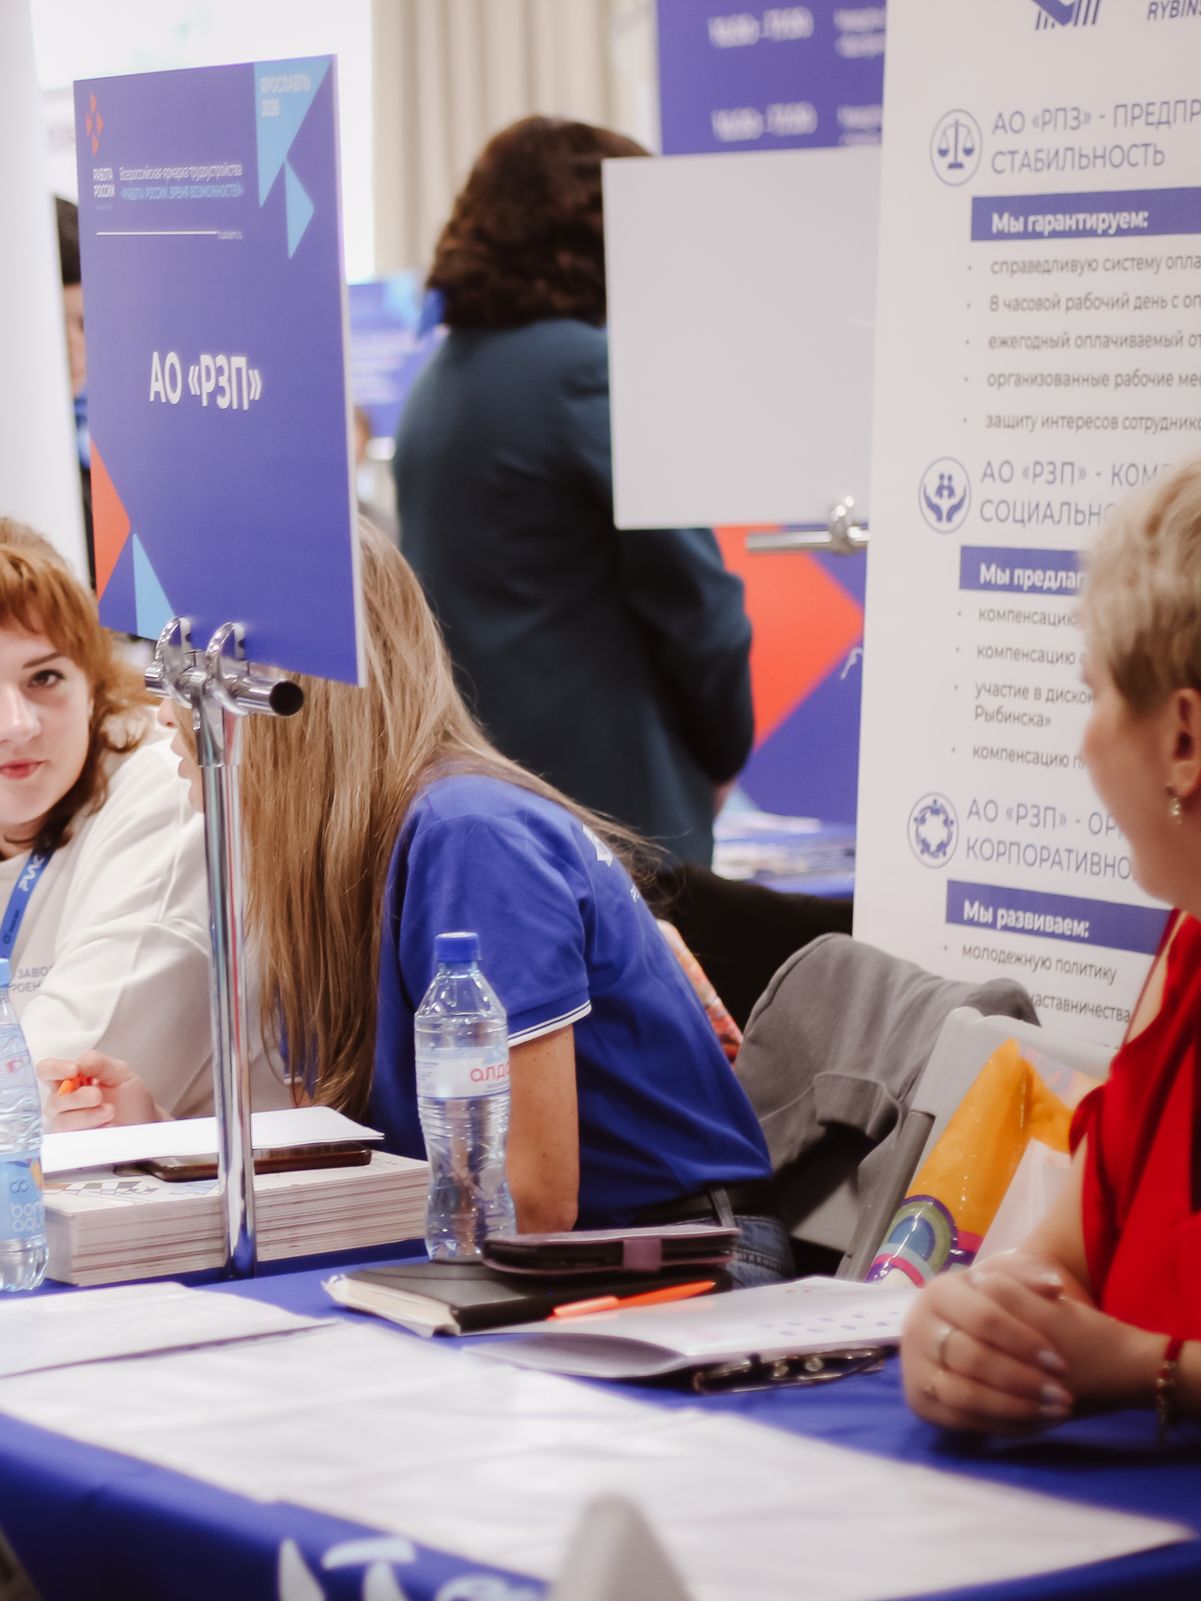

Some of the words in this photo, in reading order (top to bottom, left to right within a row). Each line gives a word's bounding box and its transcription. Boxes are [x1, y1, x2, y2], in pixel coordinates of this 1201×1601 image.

[1146, 0, 1201, 20] RYBIN
[992, 111, 1026, 135] АО
[1032, 107, 1091, 132] «РПЗ»
[1114, 99, 1201, 130] ПРЕДПР
[991, 143, 1165, 175] СТАБИЛЬНОСТЬ
[991, 211, 1024, 234] Мы
[1027, 210, 1149, 236] гарантируем:
[990, 257, 1099, 277] справедливую
[1102, 255, 1162, 275] систему
[1003, 293, 1061, 312] часовой
[1065, 292, 1130, 313] рабочий
[1133, 295, 1168, 311] день
[1171, 295, 1179, 309] с
[988, 332, 1070, 351] ежегодный
[1074, 330, 1184, 349] оплачиваемый
[149, 351, 182, 404] АО
[188, 353, 262, 410] «РЗП»
[986, 371, 1110, 391] организованные
[1113, 368, 1174, 391] рабочие
[1178, 373, 1201, 388] ме
[985, 414, 1038, 433] защиту
[1041, 415, 1119, 433] интересов
[980, 460, 1015, 484] АО
[1022, 460, 1087, 486] «РЗП»
[1111, 463, 1171, 487] КОМ
[979, 562, 1009, 586] Мы
[976, 645, 1076, 666] компенсацию
[974, 682, 1030, 700] участие
[1034, 687, 1042, 701] в
[974, 705, 1052, 728] Рыбинска»
[972, 745, 1070, 769] компенсацию
[966, 797, 999, 823] АО
[1006, 802, 1068, 831] «РЗП»
[1088, 811, 1122, 838] ОР
[962, 898, 993, 924] Мы
[997, 909, 1091, 939] развиваем:
[961, 943, 1052, 973] молодежную
[1055, 957, 1118, 987] политику
